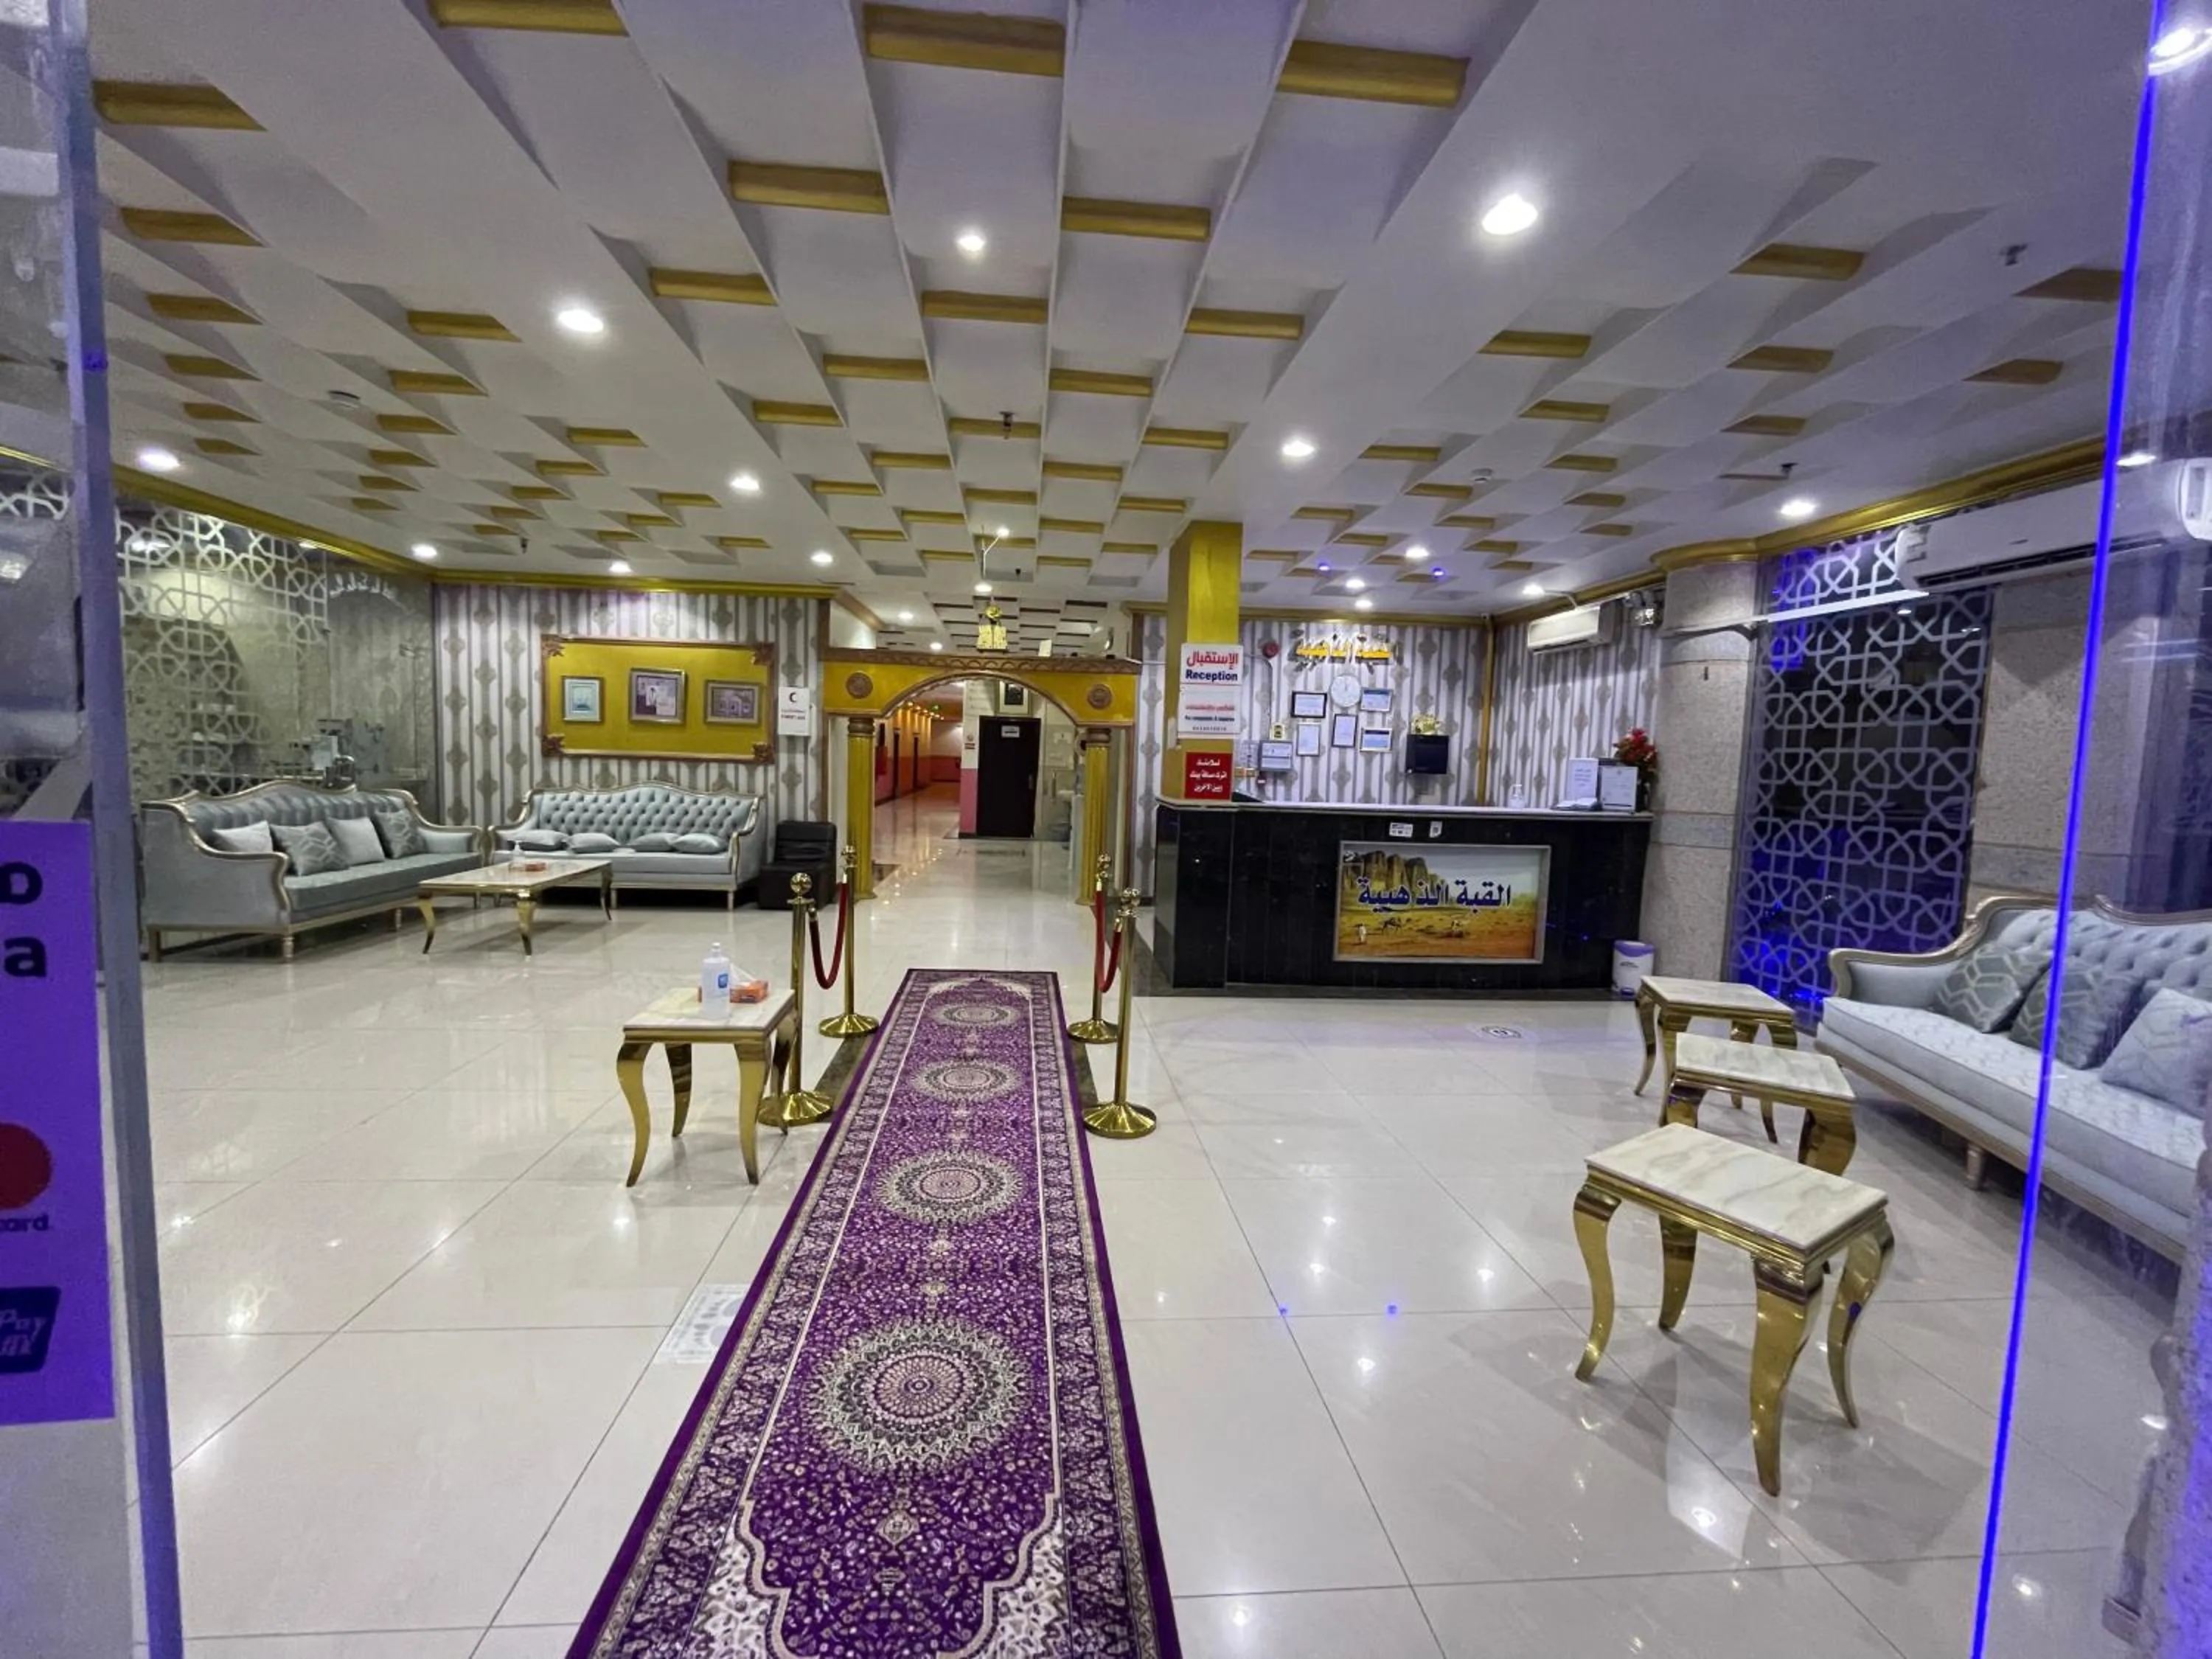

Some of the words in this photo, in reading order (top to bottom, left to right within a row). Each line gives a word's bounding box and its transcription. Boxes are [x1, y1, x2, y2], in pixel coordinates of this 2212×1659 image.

[1186, 650, 1239, 669] الإستقبال
[1186, 668, 1238, 683] Reception
[1356, 876, 1450, 914] الذهبية
[1455, 879, 1511, 913] القبة
